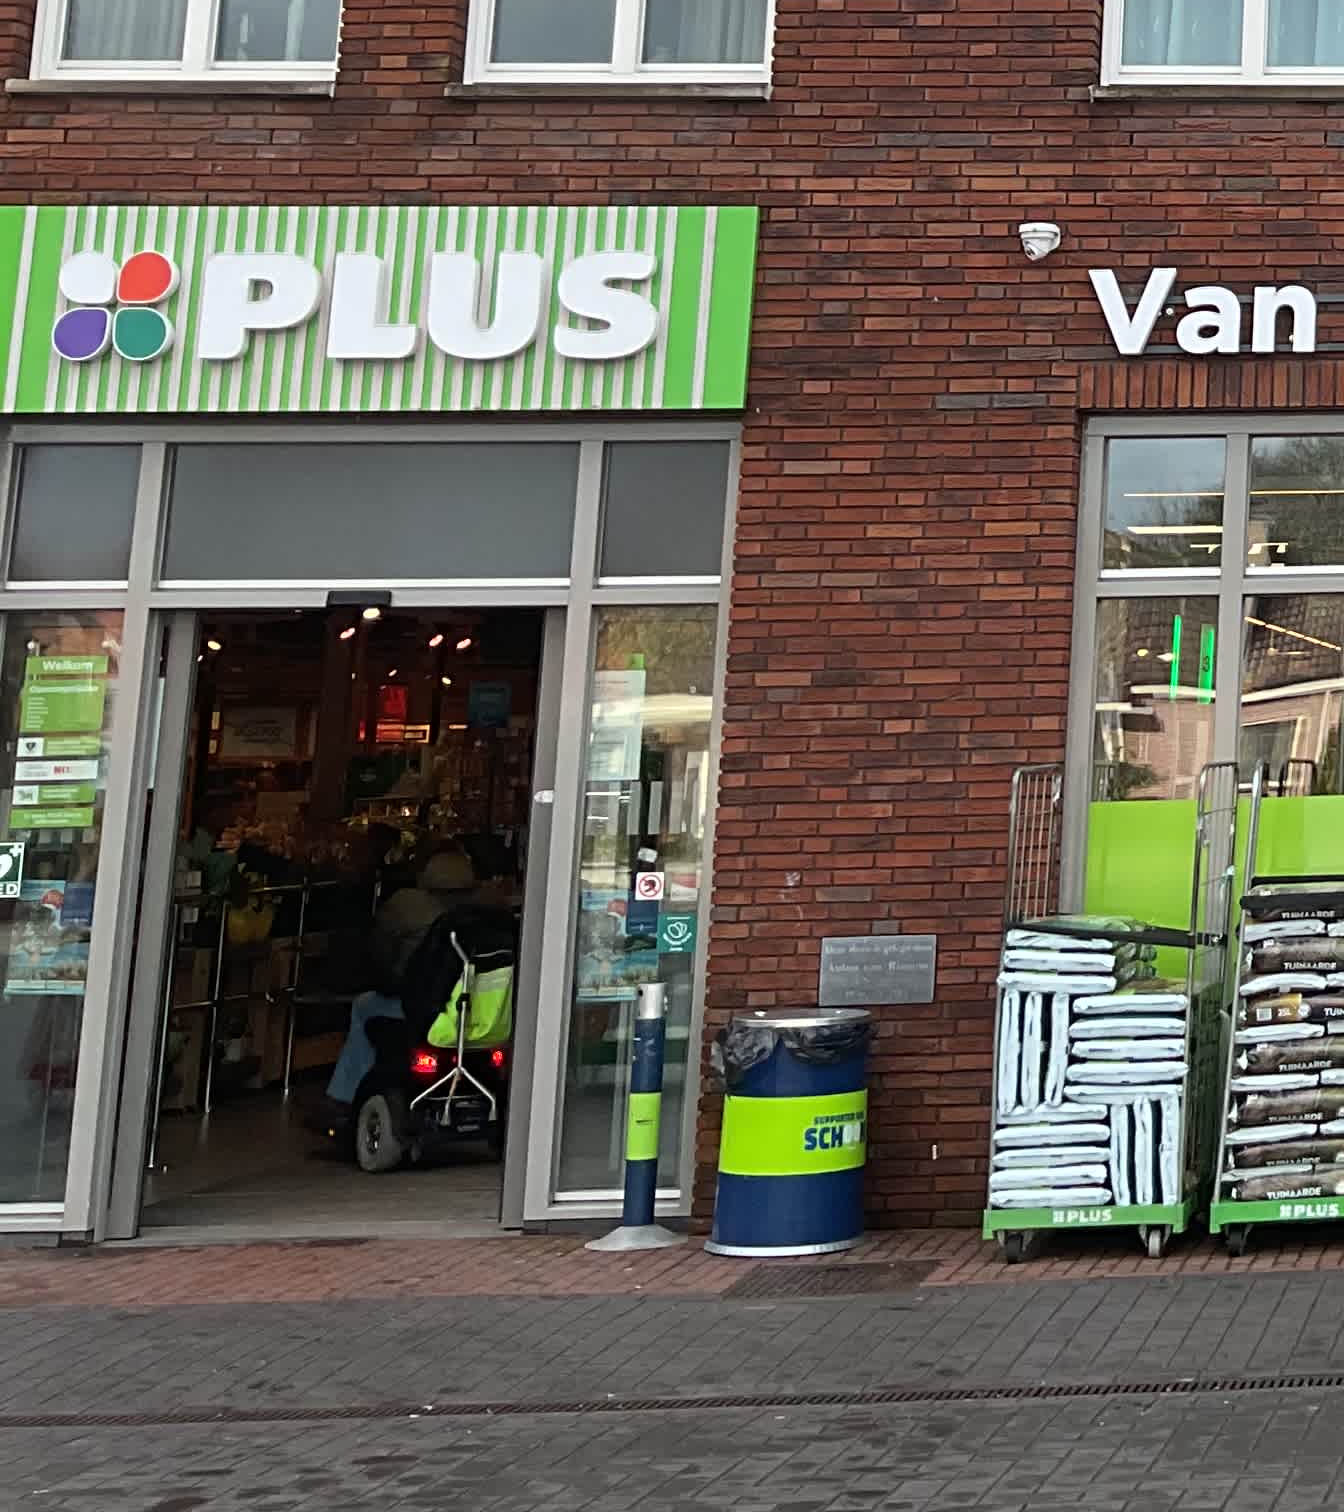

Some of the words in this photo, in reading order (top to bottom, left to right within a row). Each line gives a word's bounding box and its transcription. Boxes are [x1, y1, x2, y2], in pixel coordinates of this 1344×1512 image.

[198, 250, 660, 361] PLUS
[1087, 266, 1318, 355] Van
[1066, 1208, 1112, 1224] PLUS
[1294, 1203, 1339, 1217] PLUS
